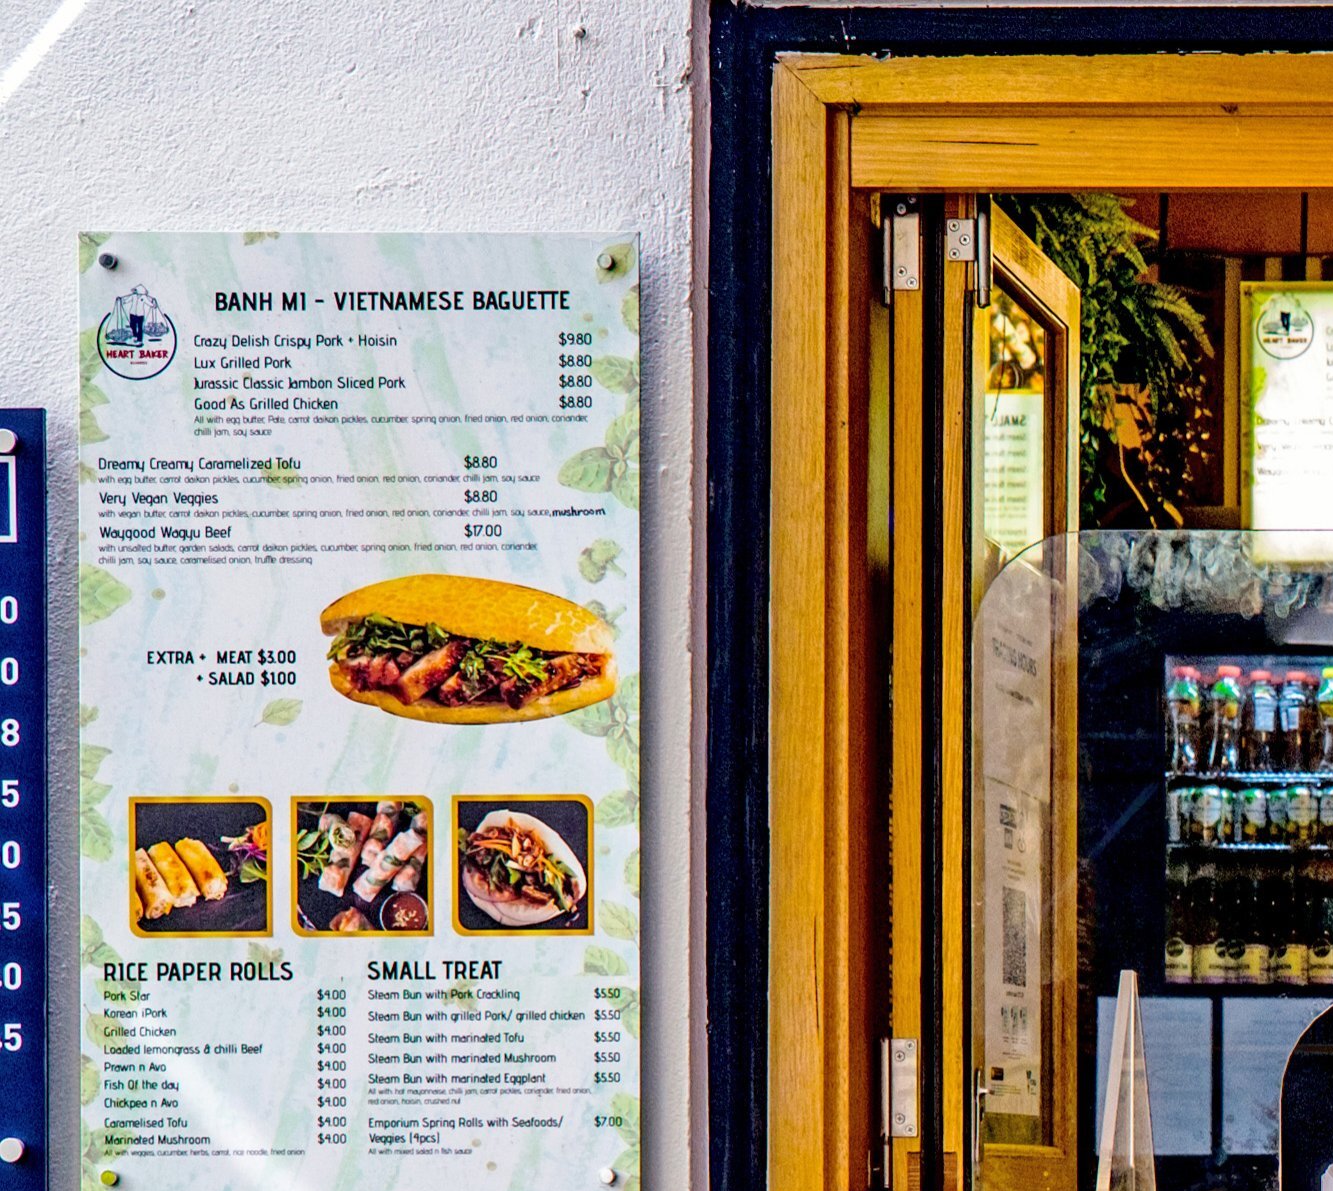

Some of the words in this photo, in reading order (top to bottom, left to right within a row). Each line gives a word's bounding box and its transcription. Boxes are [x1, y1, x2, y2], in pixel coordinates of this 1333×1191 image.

[215, 291, 273, 312] BANH
[282, 291, 306, 312] MI
[333, 290, 464, 311] VIETNAMESE
[473, 290, 570, 311] BAGUETTE
[193, 334, 228, 350] Crazy
[231, 334, 270, 348] Delish
[274, 334, 312, 350] Crispy
[315, 334, 344, 347] Pork
[358, 334, 398, 347] Hoisin
[105, 349, 136, 360] HEART
[138, 349, 169, 360] BAKER
[194, 356, 216, 369] Lux
[220, 356, 260, 369] Grilled
[264, 356, 292, 369] Pork
[99, 491, 127, 507] Very
[131, 491, 168, 507] Vegan
[173, 491, 219, 507] Veggies
[146, 650, 195, 665] EXTRA
[216, 650, 253, 665] MEAT
[208, 671, 256, 686] SALAD
[103, 962, 148, 982] RICE
[156, 962, 222, 982] PAPER
[230, 961, 294, 981] ROLLS
[367, 960, 437, 981] SMALL
[442, 960, 503, 980] TREAT
